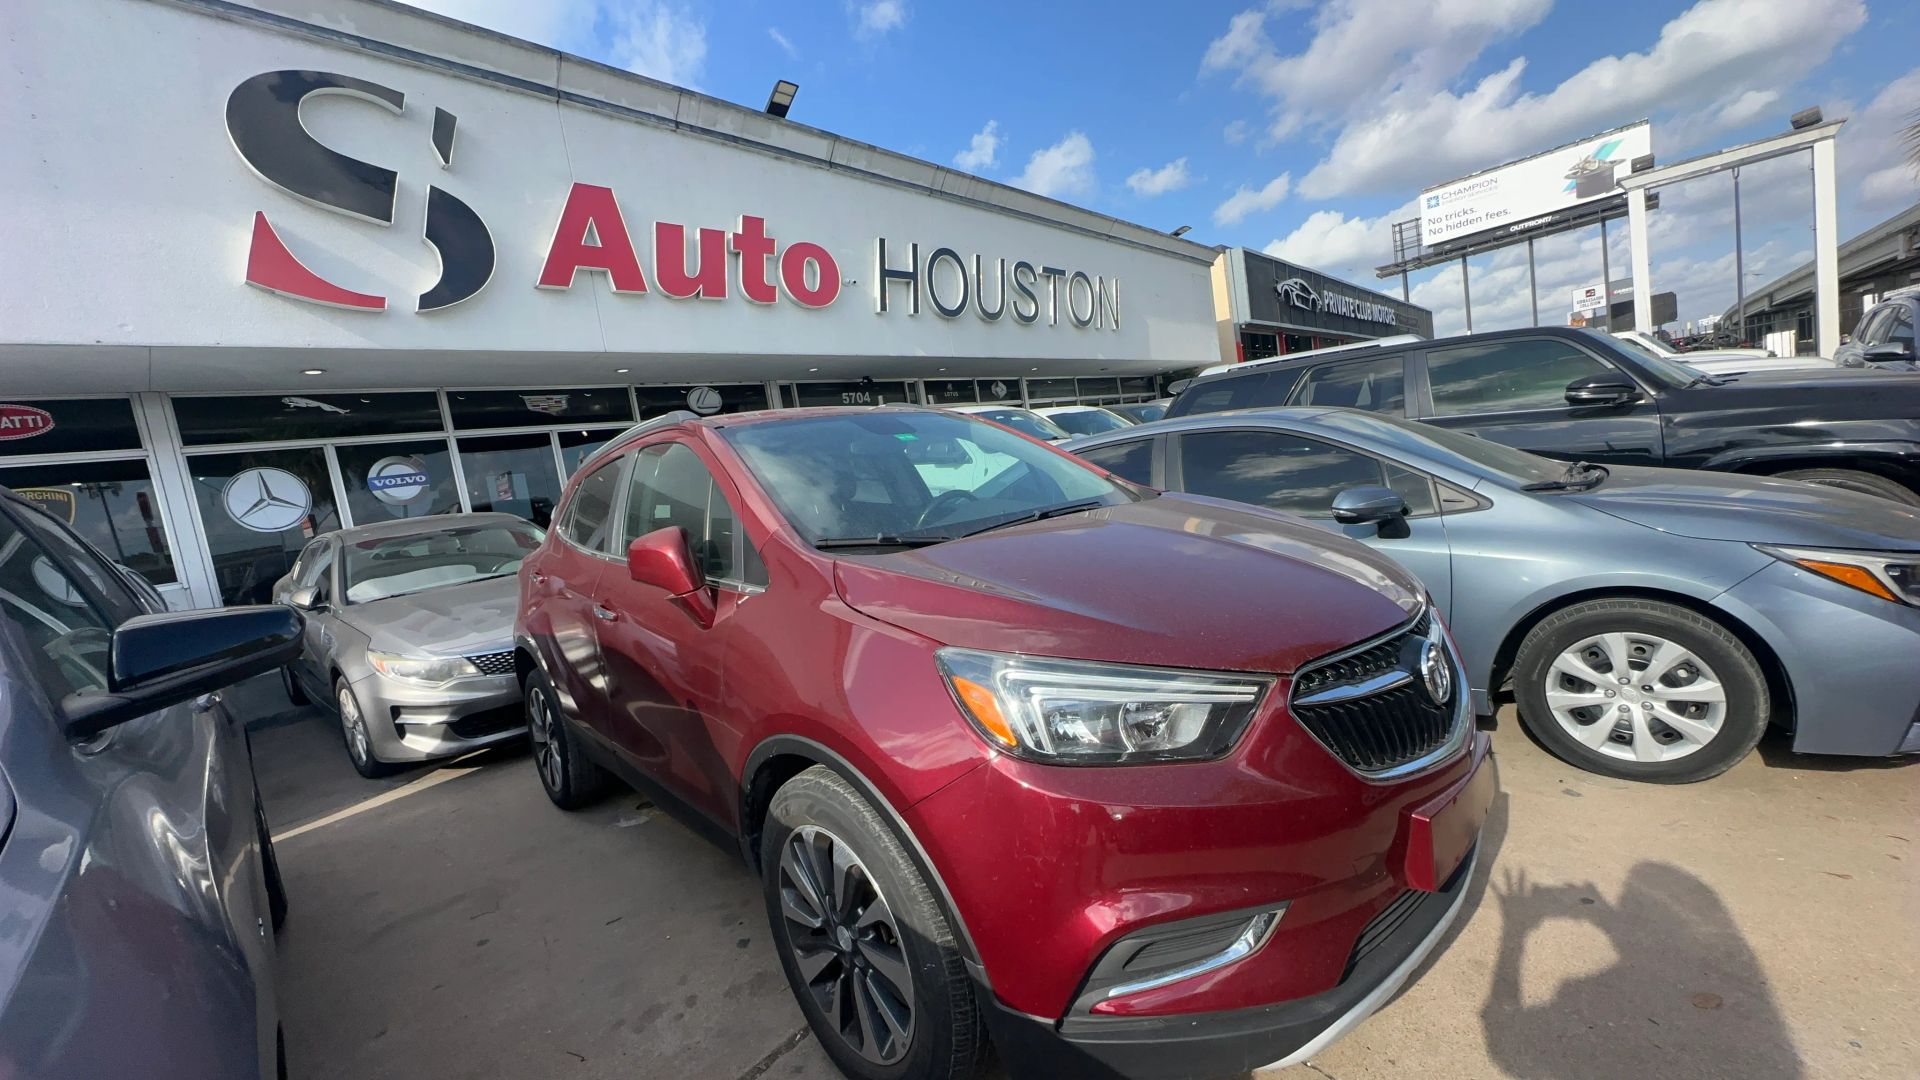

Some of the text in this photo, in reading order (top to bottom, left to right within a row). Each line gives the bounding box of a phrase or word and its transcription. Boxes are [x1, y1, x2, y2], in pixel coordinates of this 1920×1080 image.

[1441, 177, 1498, 200] CHAMPION
[1428, 207, 1478, 226] No tricks.
[1429, 208, 1511, 237] No hidden fees.
[536, 181, 1121, 330] Auto HOUSTON
[1323, 290, 1396, 326] PRIVATE CLUB MOTORS
[842, 391, 871, 404] 5704
[371, 474, 426, 488] VOLVO
